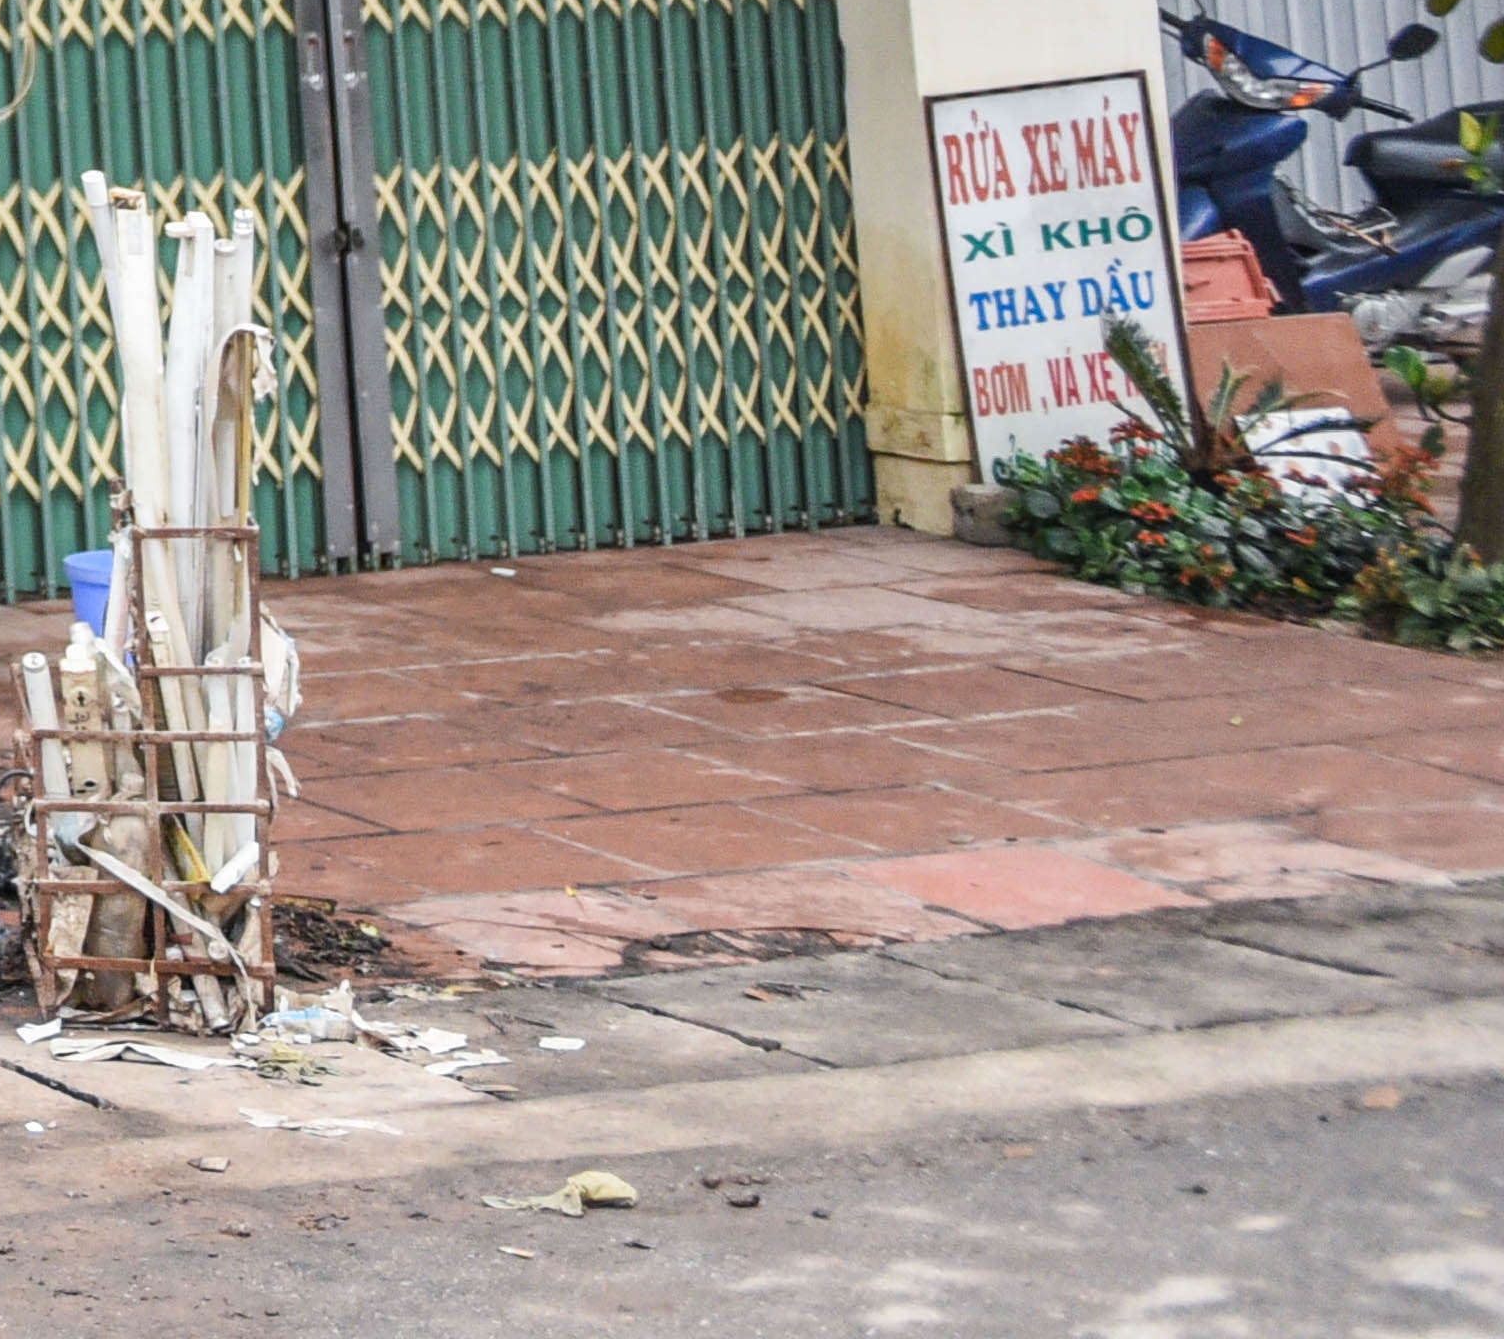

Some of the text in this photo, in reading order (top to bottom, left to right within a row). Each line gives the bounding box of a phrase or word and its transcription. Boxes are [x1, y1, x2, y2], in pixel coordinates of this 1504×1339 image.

[942, 96, 1142, 206] RỬA XE MÁY
[961, 206, 1154, 263] XÌ KHÔ
[968, 258, 1156, 332] THAY DẦU
[972, 360, 1032, 418] BƠM
[1082, 351, 1118, 404] XE
